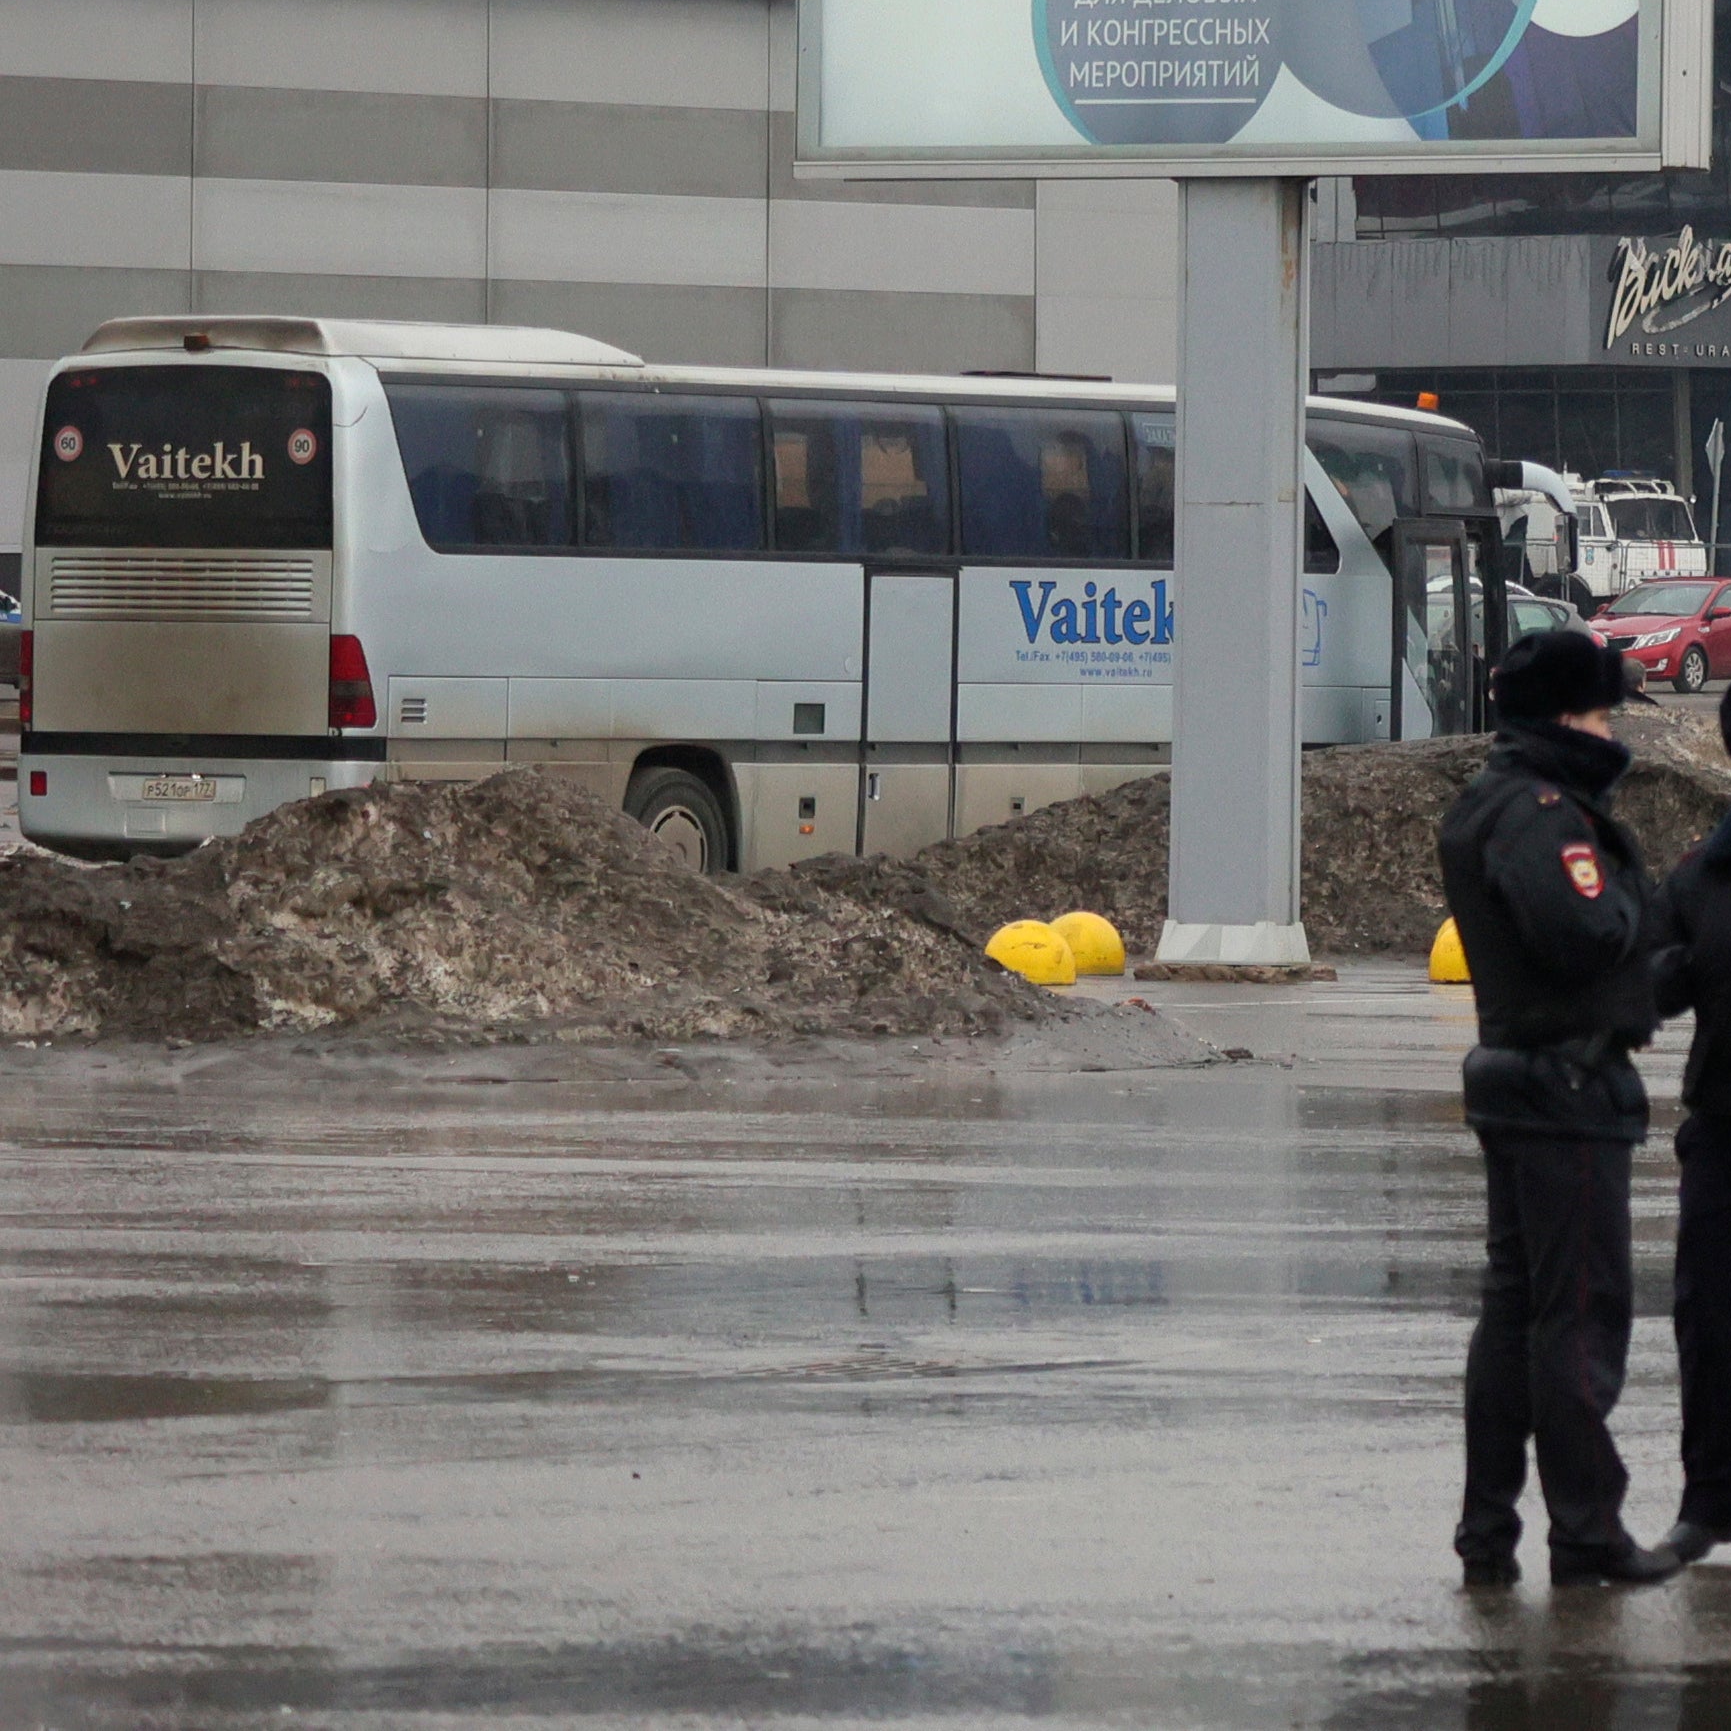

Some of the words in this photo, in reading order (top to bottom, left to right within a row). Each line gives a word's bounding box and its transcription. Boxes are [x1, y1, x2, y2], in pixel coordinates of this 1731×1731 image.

[1060, 20, 1079, 47] И
[1087, 17, 1270, 48] КОНГРЕССНЫХ
[1069, 54, 1260, 88] МЕРОПРИЯТИЙ
[61, 436, 76, 451] 60
[294, 439, 310, 453] 90
[107, 441, 265, 479] Vaitekh
[1009, 579, 1174, 645] Vaitek
